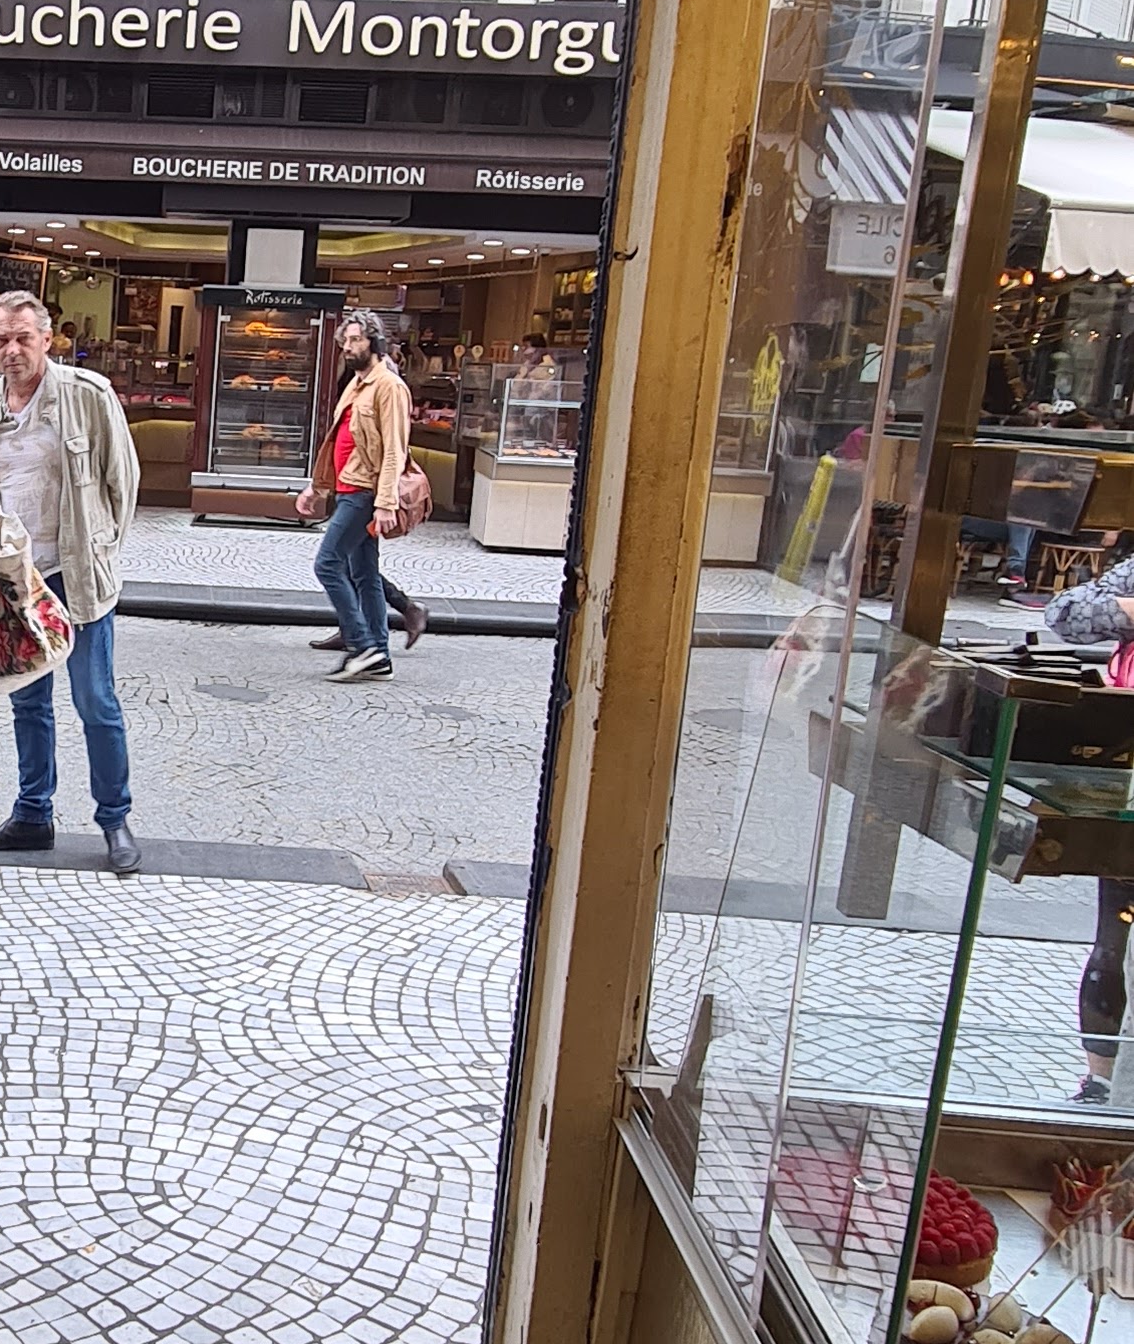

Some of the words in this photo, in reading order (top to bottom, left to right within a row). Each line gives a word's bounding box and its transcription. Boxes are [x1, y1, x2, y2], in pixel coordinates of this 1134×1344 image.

[132, 157, 263, 180] BOUCHERIE
[269, 162, 300, 181] DE
[305, 163, 426, 186] TRADITION
[476, 169, 585, 192] Rôtisserie
[245, 288, 303, 305] Rotisserie
